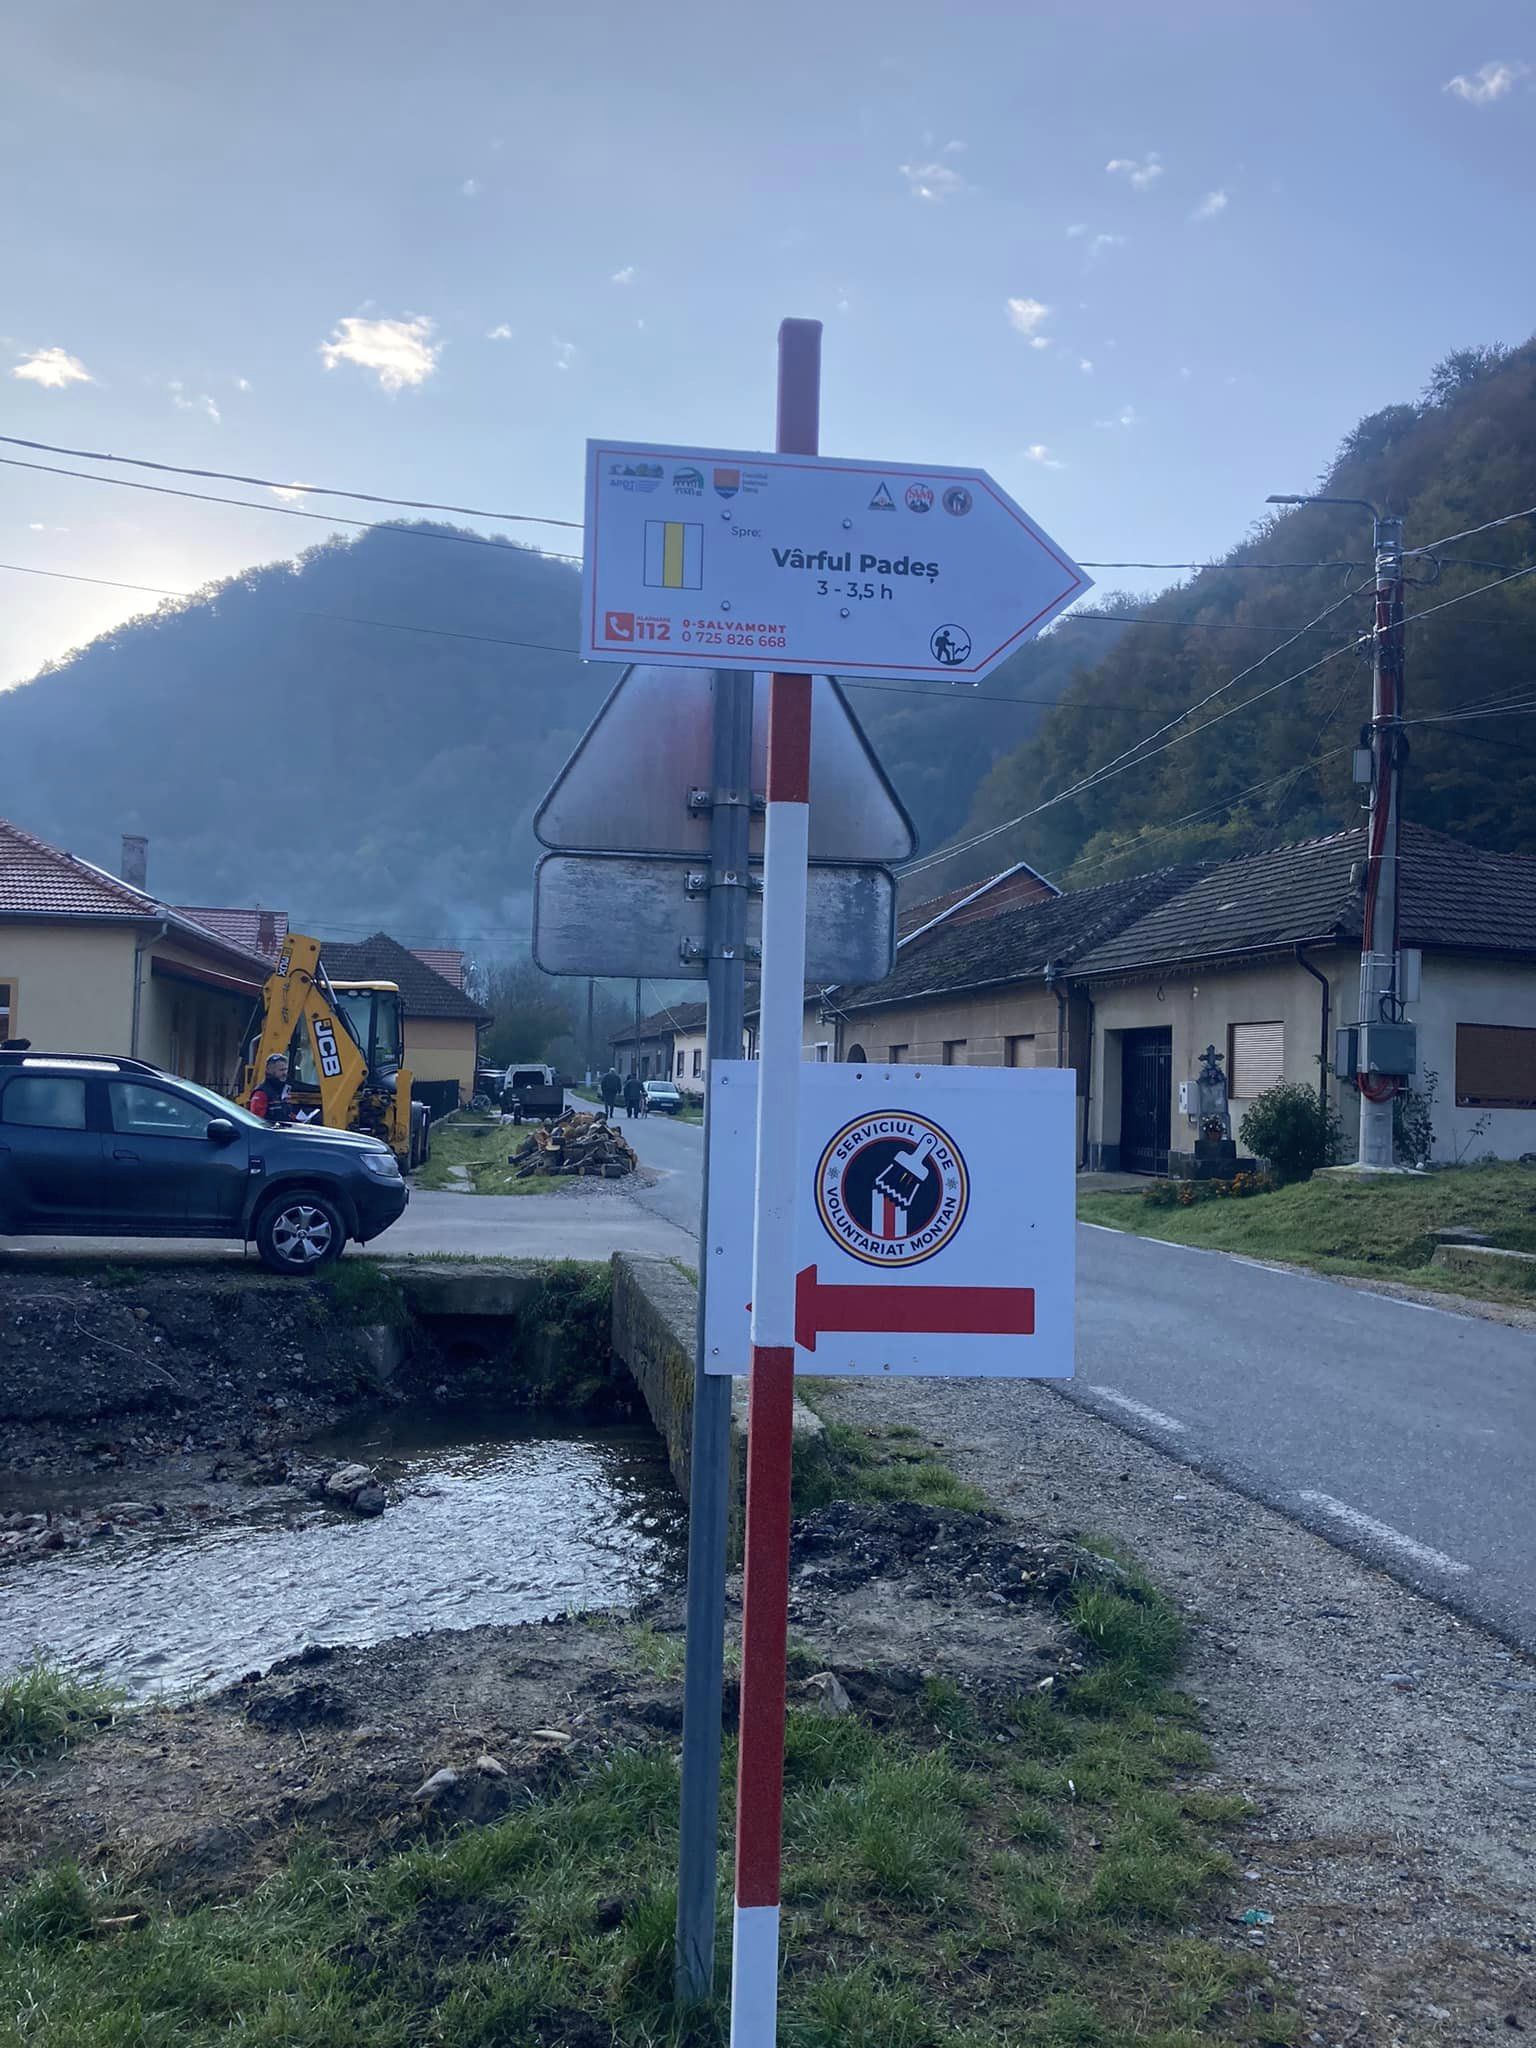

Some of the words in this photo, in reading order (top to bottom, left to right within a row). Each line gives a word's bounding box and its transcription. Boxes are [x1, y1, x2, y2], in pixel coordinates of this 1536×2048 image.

[771, 548, 850, 572] Vârful
[860, 554, 939, 584] Padeș
[817, 580, 828, 596] 3
[846, 582, 875, 600] 3,5
[880, 584, 893, 600] h
[636, 622, 671, 641] 112
[682, 631, 691, 642] 0
[695, 632, 722, 644] 725
[726, 633, 754, 646] 826
[758, 635, 786, 648] 668
[315, 1020, 341, 1077] JCB
[836, 1121, 915, 1160] SERVICIUL
[936, 1147, 954, 1171] DE
[827, 1187, 905, 1256] VOLUNTARIAT
[910, 1196, 957, 1251] MONTAN
